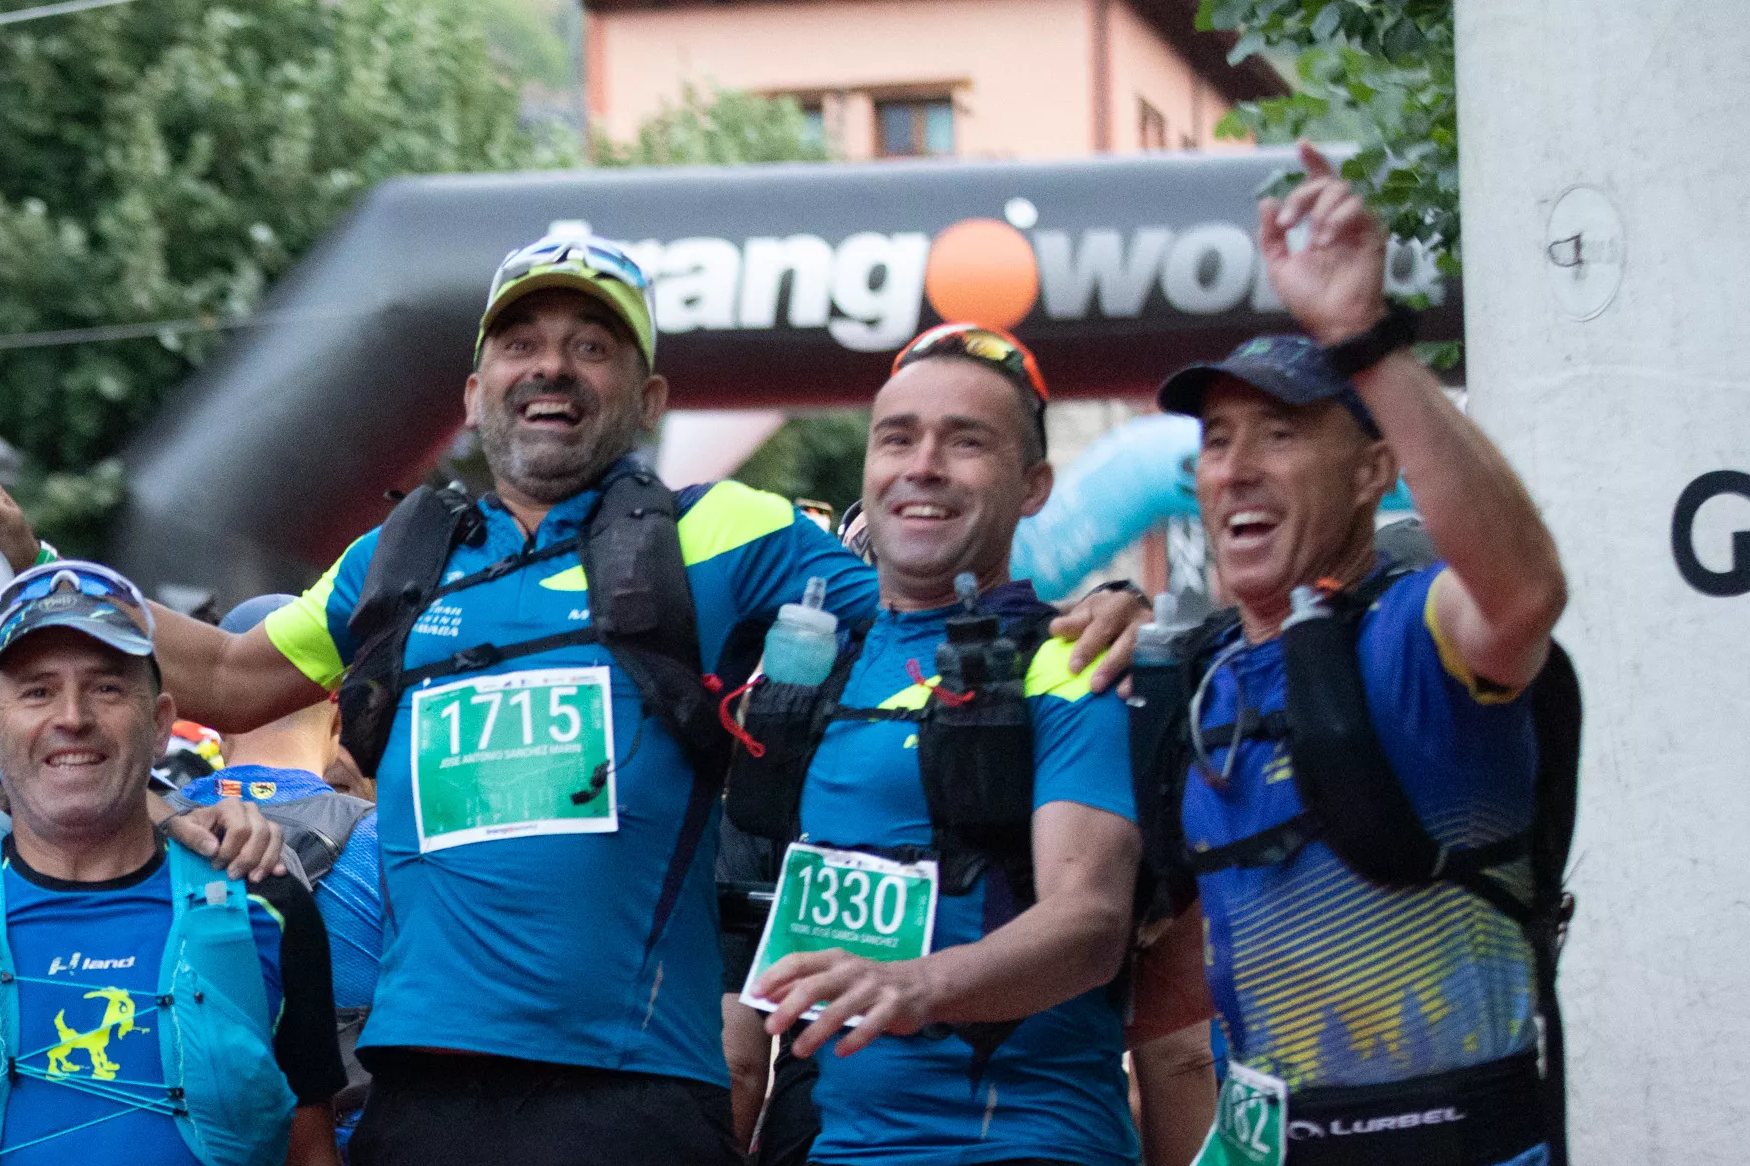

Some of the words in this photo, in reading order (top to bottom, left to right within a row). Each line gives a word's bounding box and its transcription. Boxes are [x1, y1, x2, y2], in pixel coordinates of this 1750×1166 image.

[440, 686, 581, 755] 1715
[799, 865, 907, 935] 1330
[1330, 1106, 1468, 1136] LURBEL
